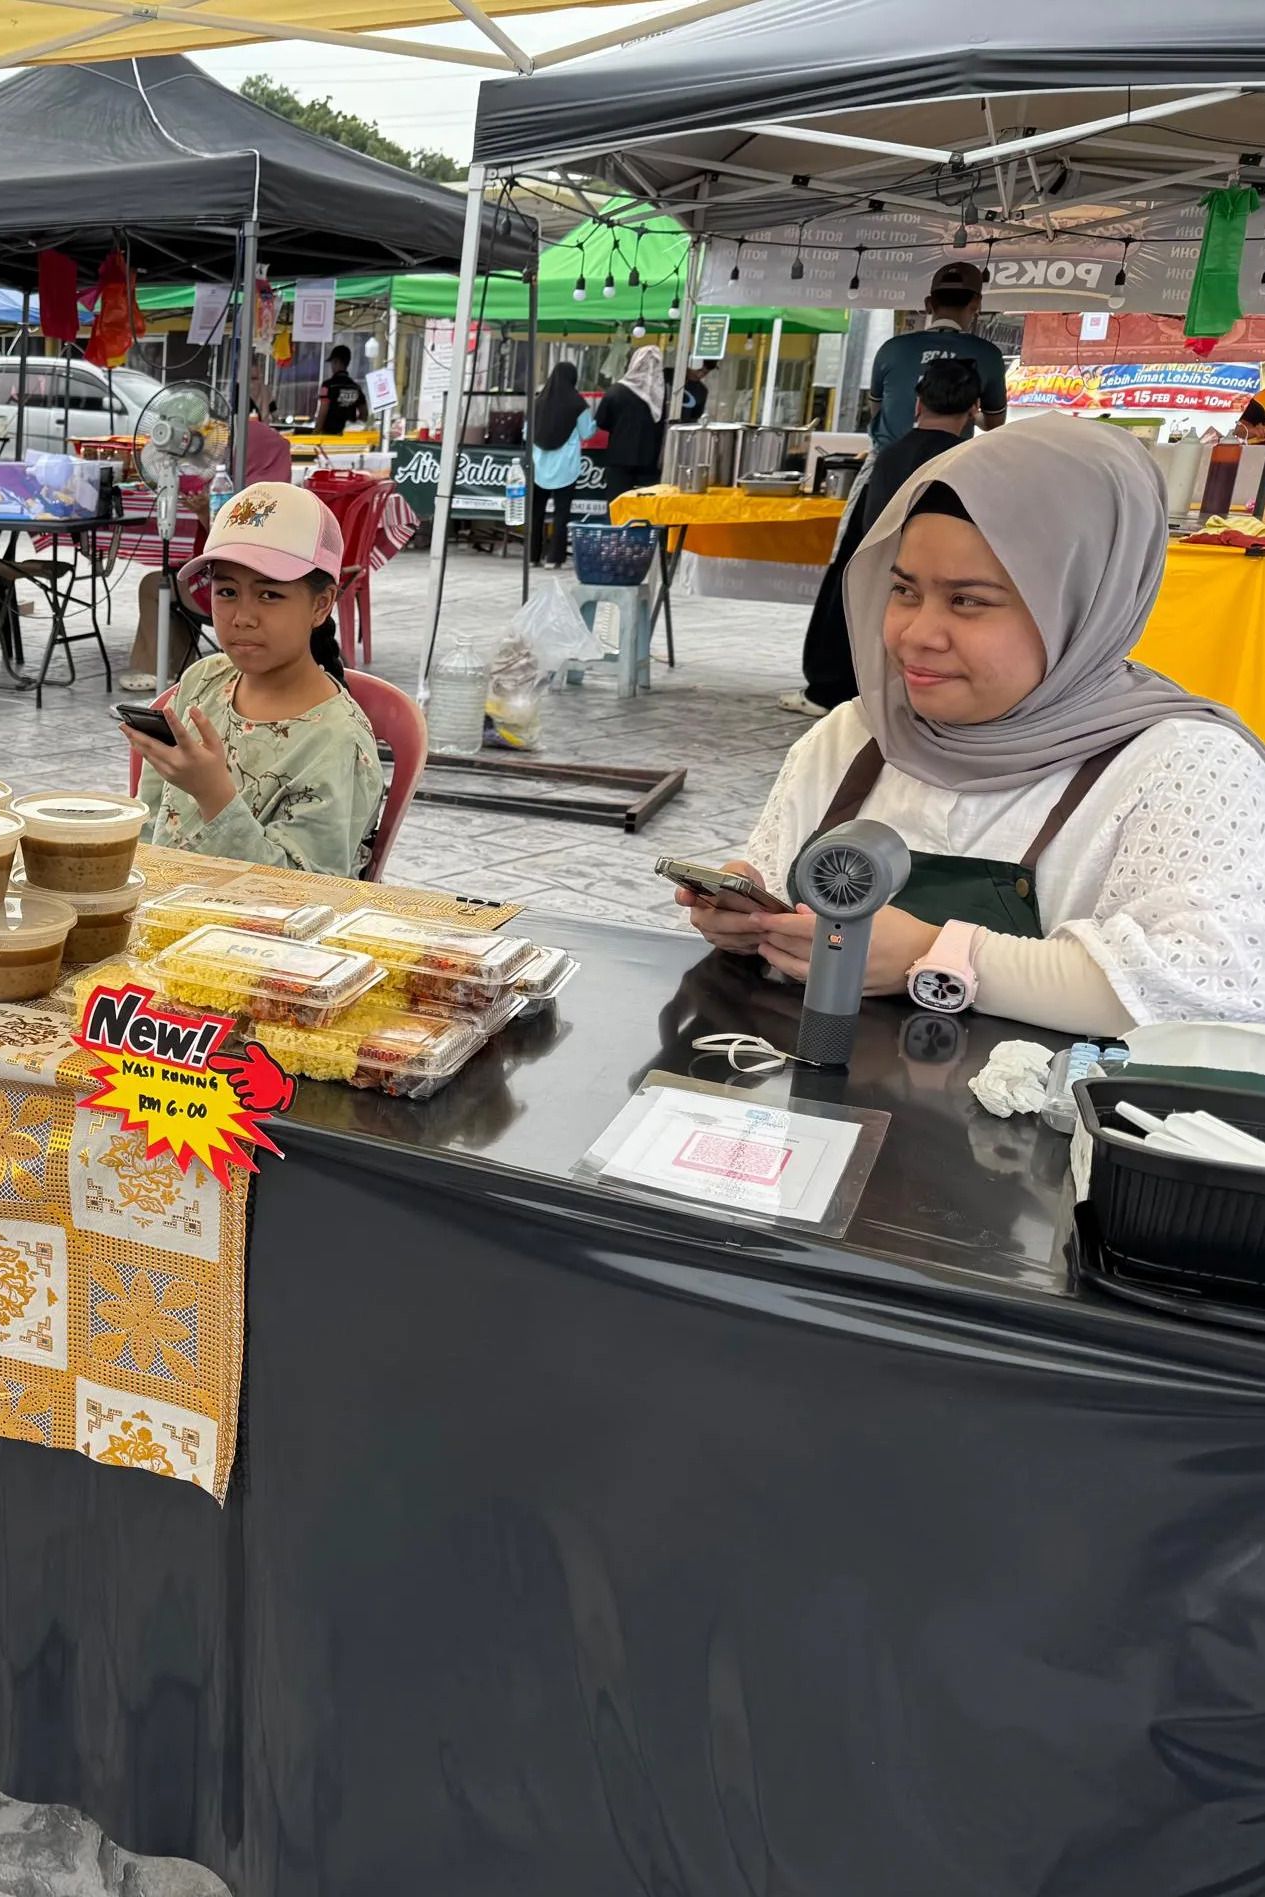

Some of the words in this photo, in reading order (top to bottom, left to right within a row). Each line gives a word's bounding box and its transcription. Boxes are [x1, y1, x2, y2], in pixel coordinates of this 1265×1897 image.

[1101, 374, 1130, 387] Lebih
[1167, 372, 1201, 384] Lebih
[1203, 374, 1261, 389] Seronok!
[1152, 393, 1171, 404] FEB
[86, 992, 222, 1067] New!
[122, 1060, 155, 1079] NASI
[162, 1068, 218, 1091] KUNING
[138, 1094, 161, 1114] RM
